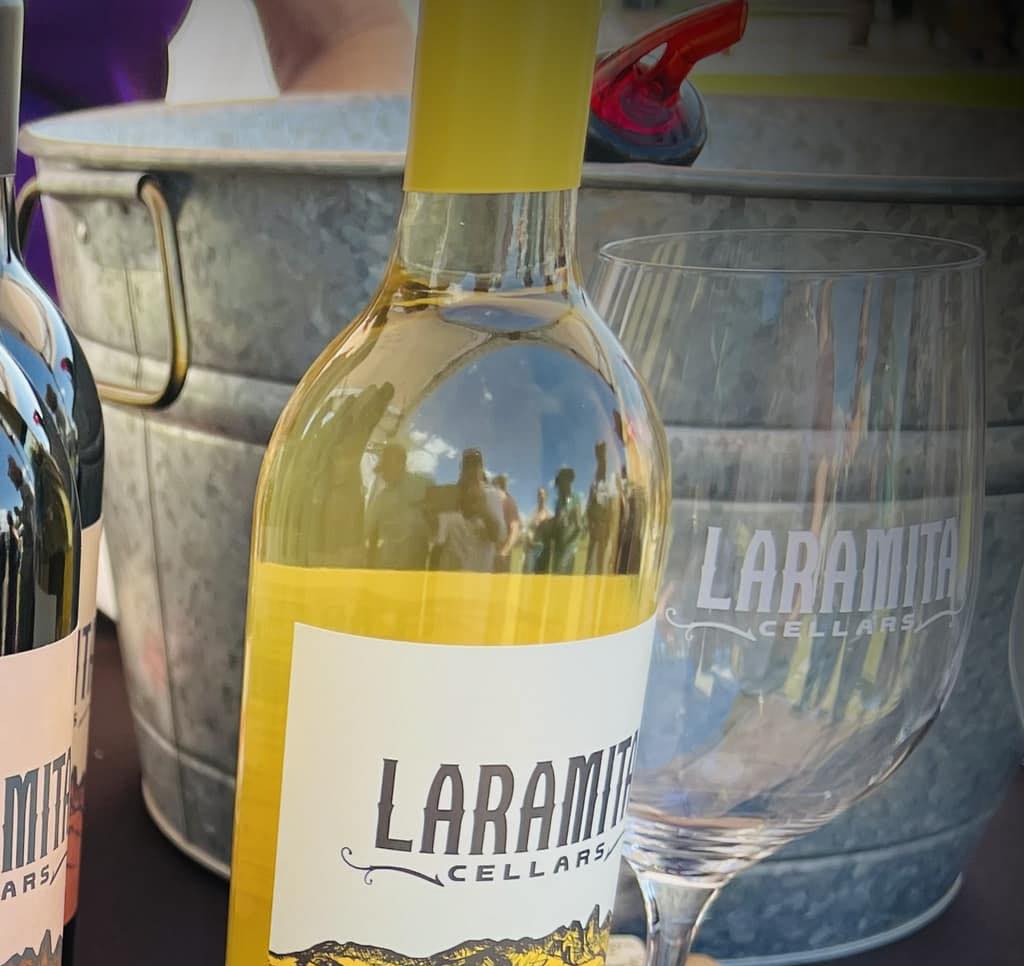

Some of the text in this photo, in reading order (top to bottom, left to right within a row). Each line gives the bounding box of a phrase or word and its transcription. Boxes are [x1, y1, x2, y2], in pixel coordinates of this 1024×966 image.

[696, 517, 958, 613] LARAMITA
[759, 612, 915, 639] CELLARS
[447, 842, 605, 883] CELLARS
